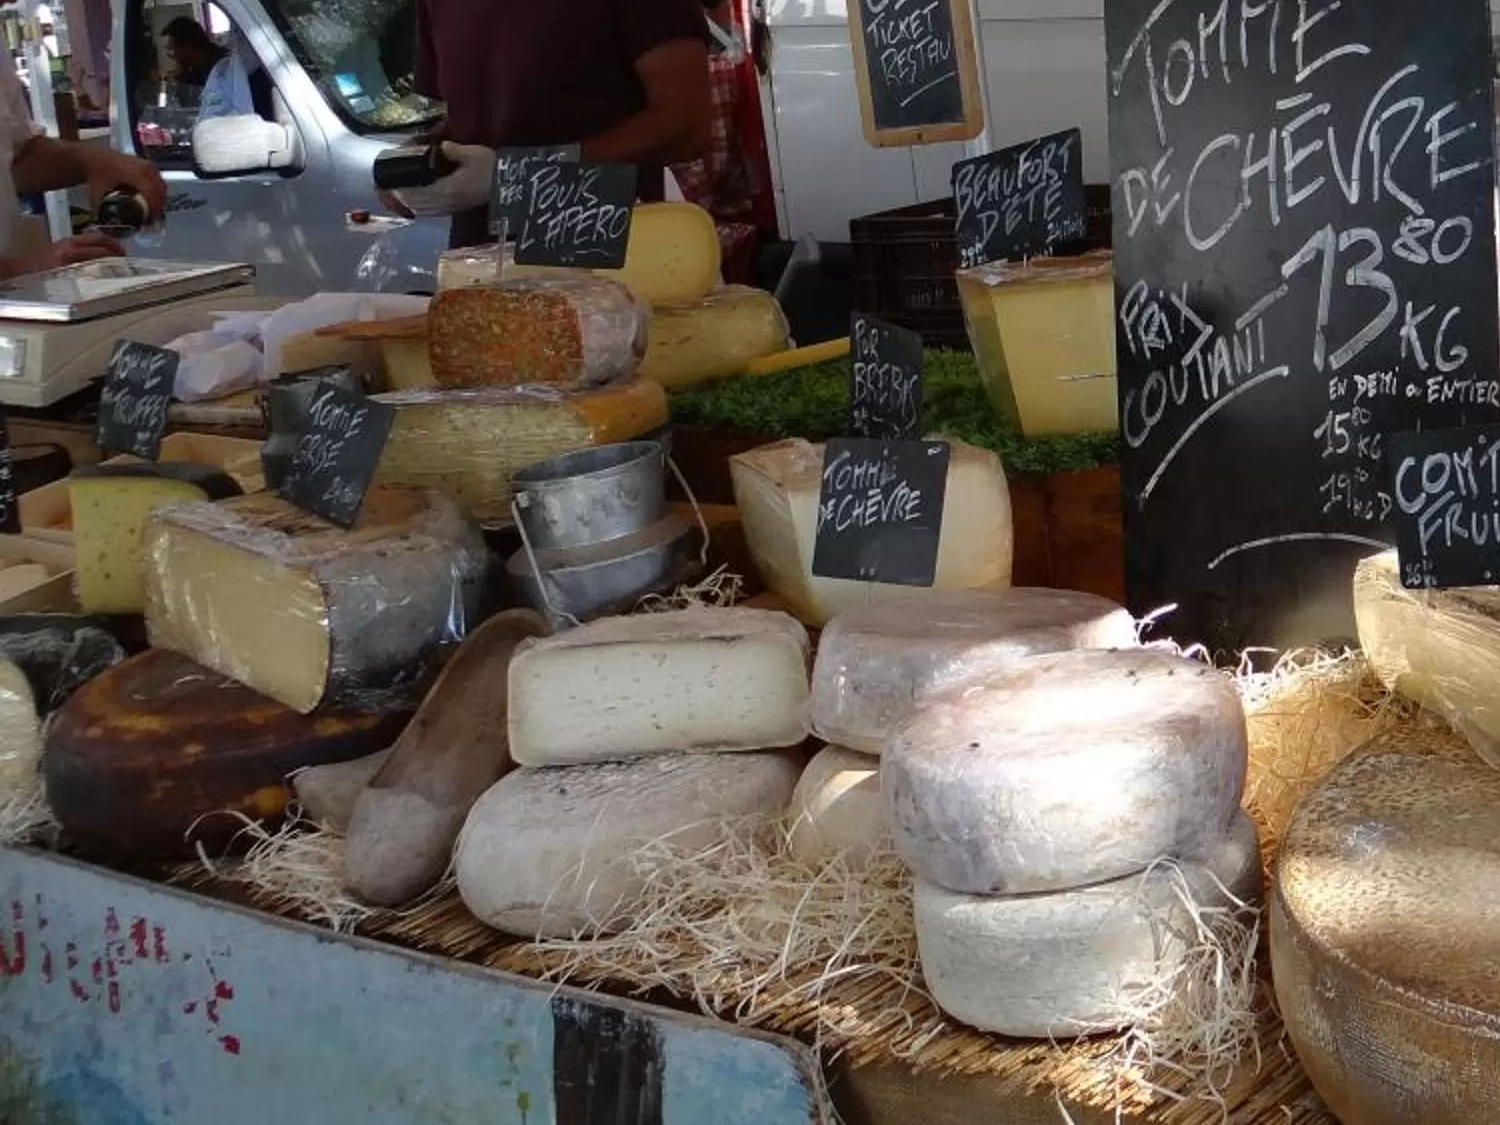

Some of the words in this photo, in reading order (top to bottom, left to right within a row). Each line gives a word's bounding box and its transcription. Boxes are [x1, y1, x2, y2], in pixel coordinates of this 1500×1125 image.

[880, 34, 951, 89] RESTAU
[955, 137, 1074, 232] BEAUFORT
[1121, 149, 1181, 238] DE
[1399, 300, 1469, 373] KG
[1329, 376, 1348, 401] EN
